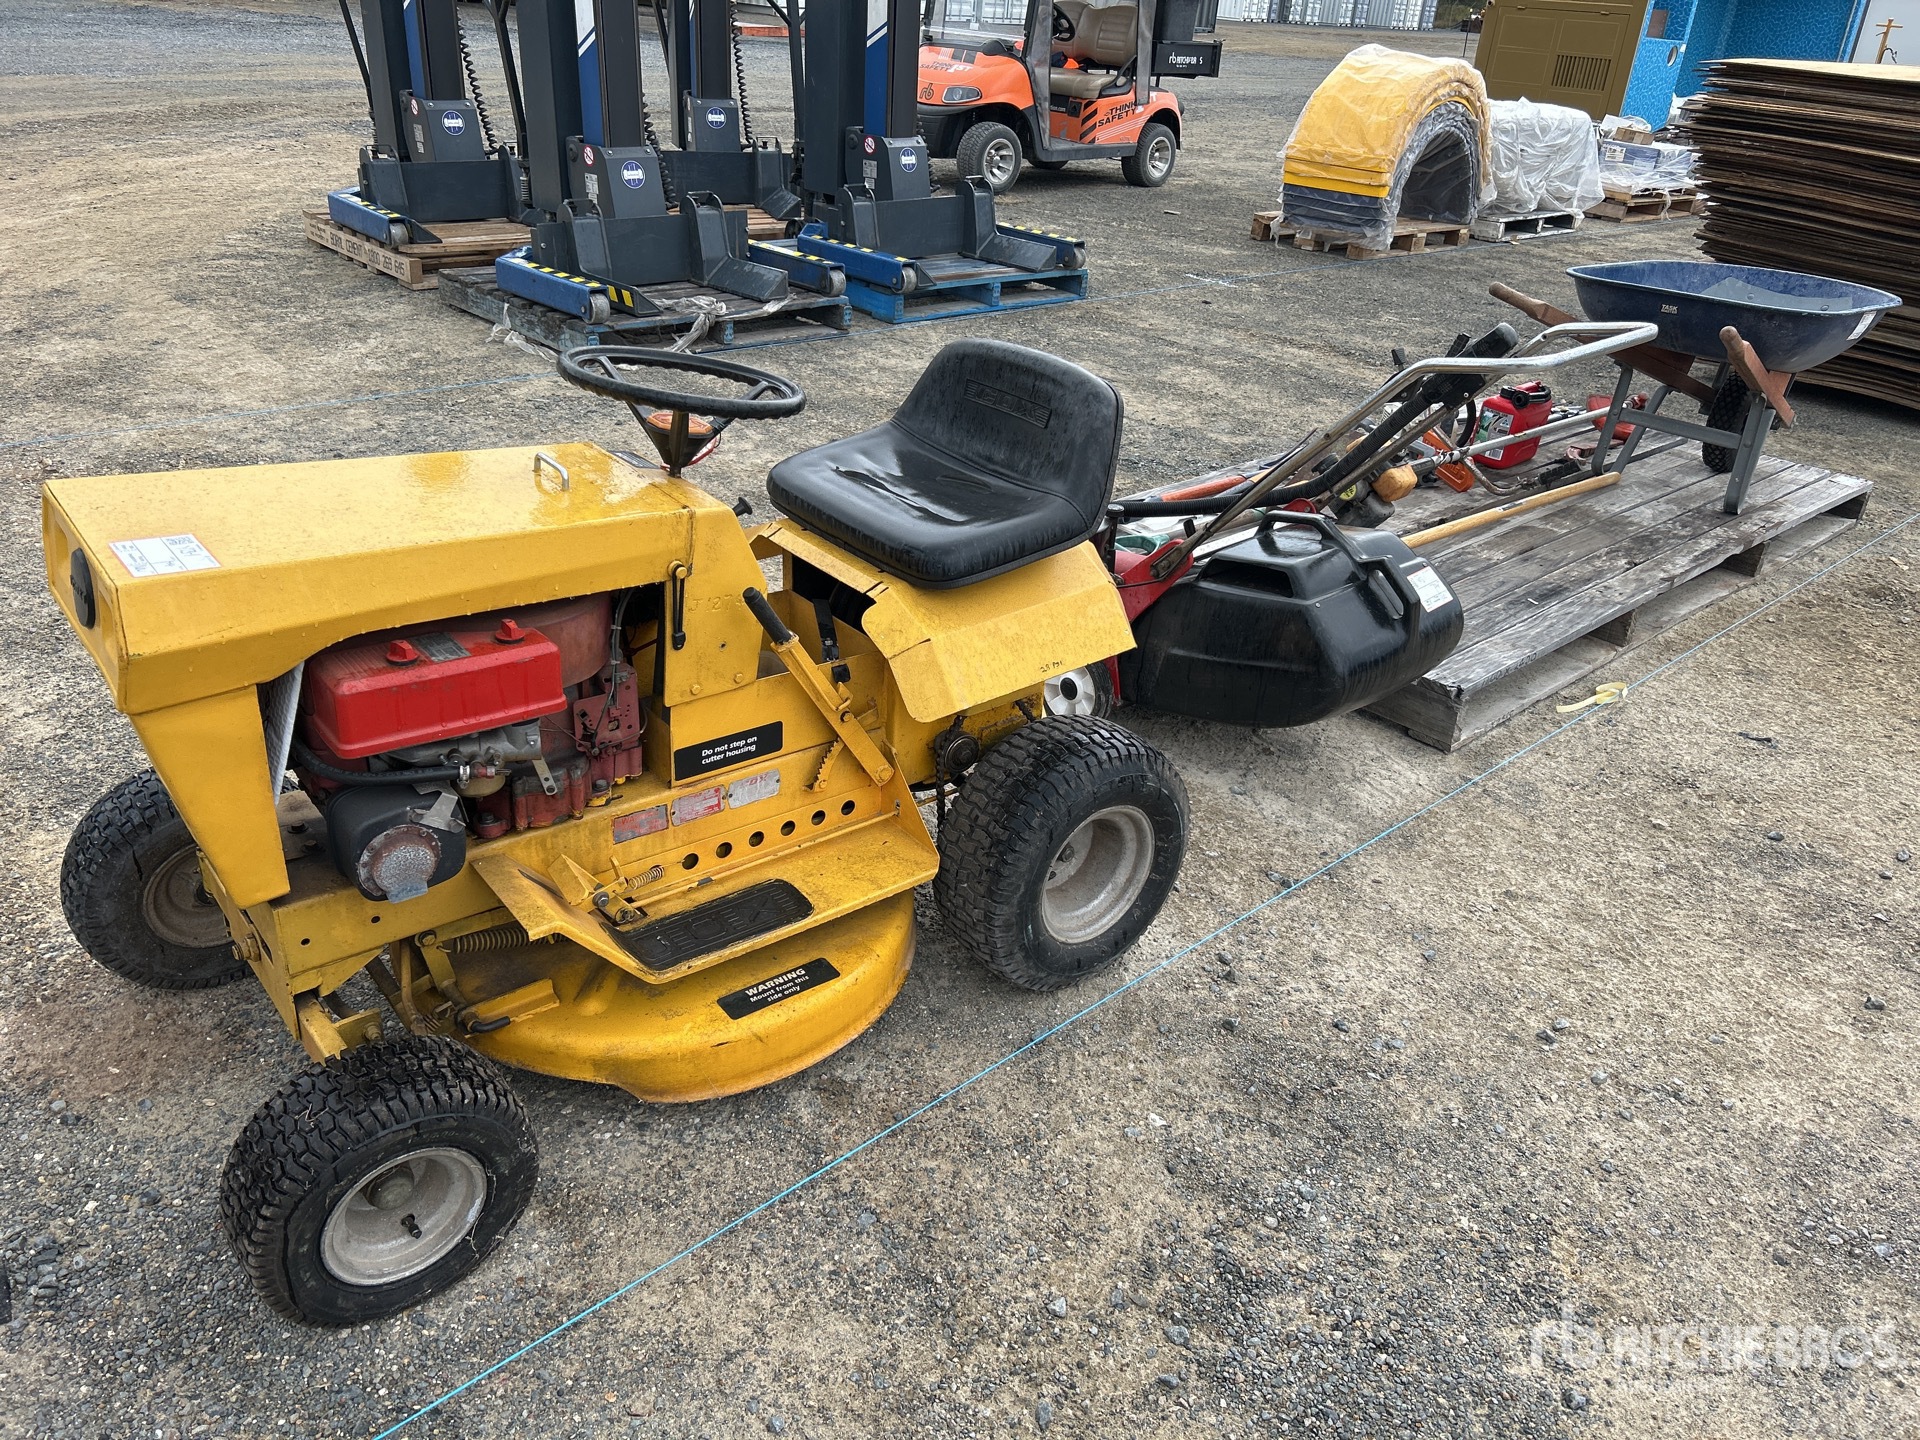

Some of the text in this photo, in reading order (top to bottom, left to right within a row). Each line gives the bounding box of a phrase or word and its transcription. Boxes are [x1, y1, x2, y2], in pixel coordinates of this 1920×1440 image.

[1097, 108, 1137, 128] SAFETY
[1109, 101, 1138, 116] THINK
[1661, 303, 1679, 311] TASK
[975, 385, 1041, 423] COX
[701, 736, 758, 757] Do not step on
[701, 744, 757, 765] cutter housing
[744, 968, 806, 997] WARNING
[749, 975, 810, 1003] Mount from this
[766, 985, 801, 1002] side only
